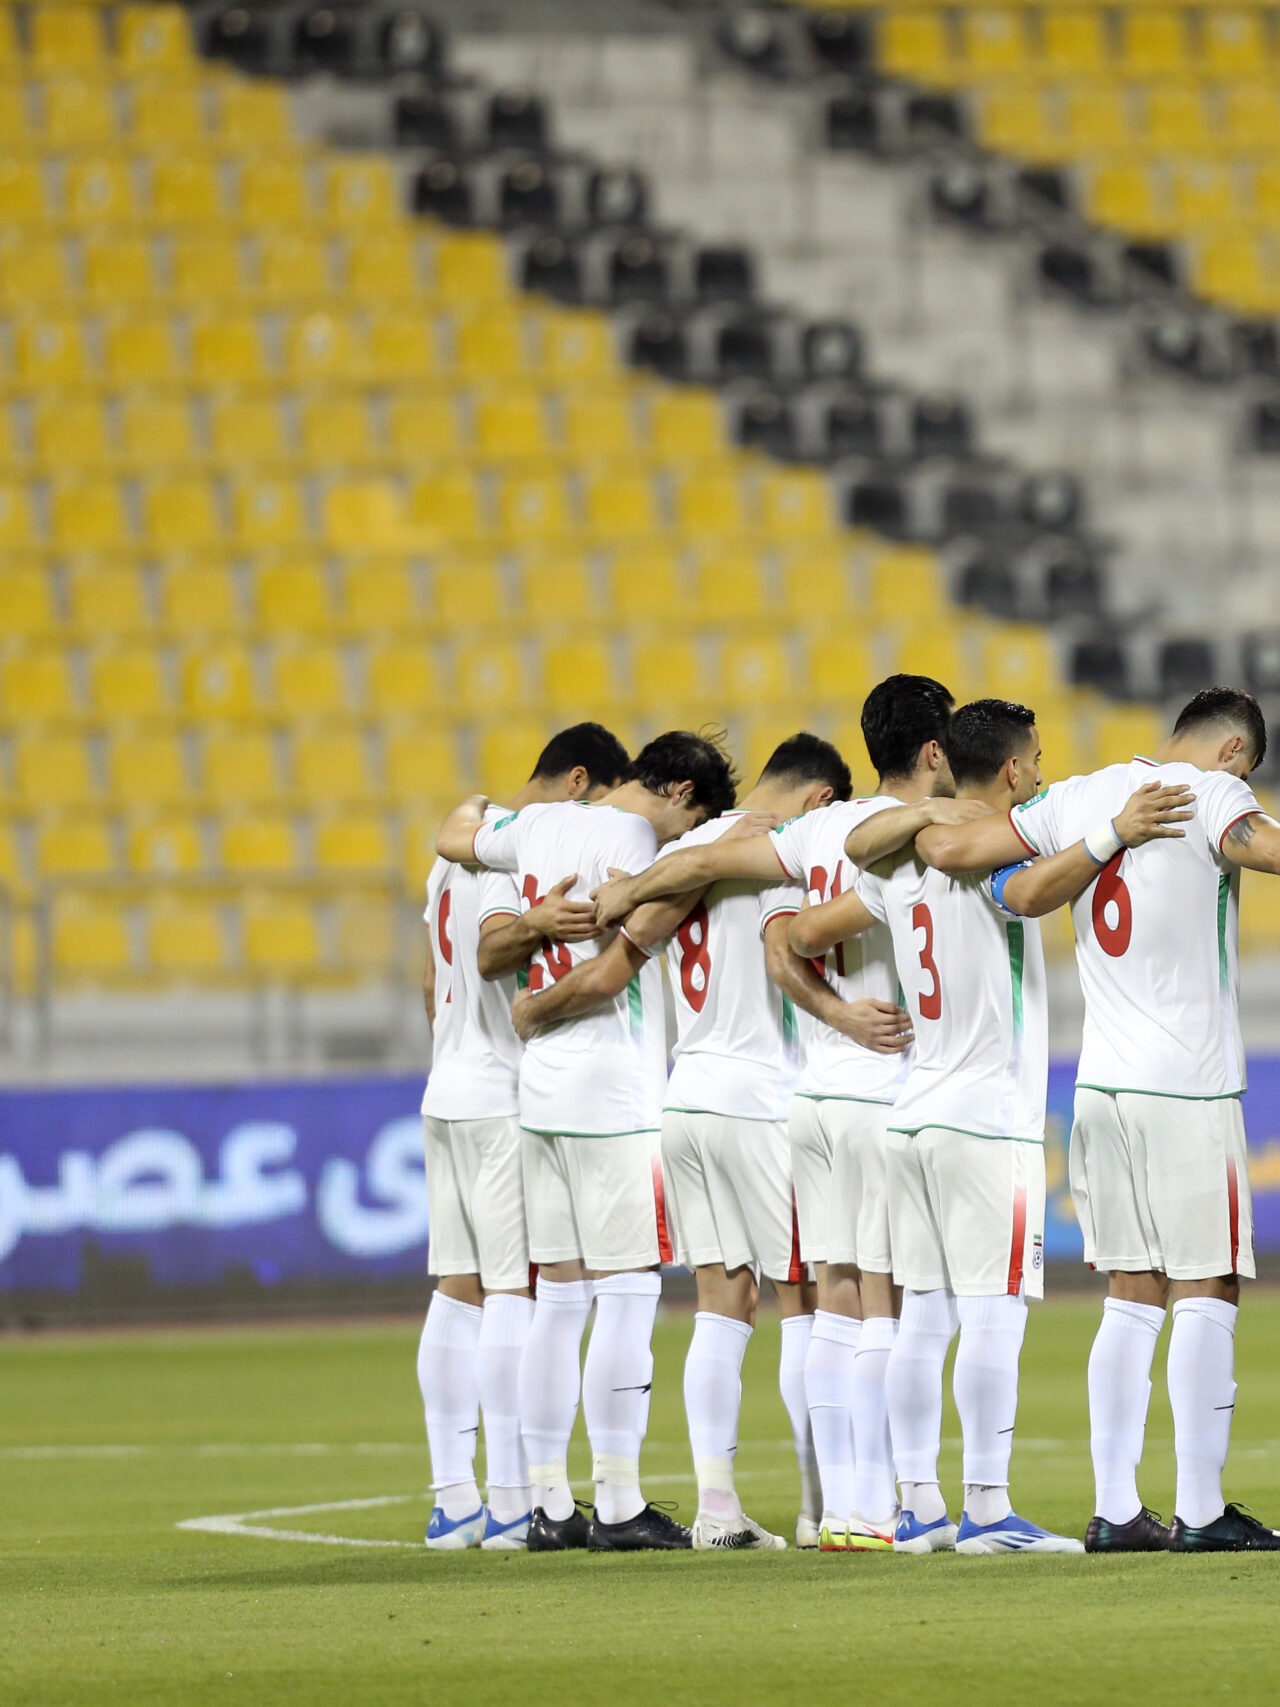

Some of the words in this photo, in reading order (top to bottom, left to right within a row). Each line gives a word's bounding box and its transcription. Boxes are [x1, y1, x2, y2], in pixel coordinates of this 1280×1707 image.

[677, 900, 712, 1014] 8
[1092, 847, 1132, 958] 6
[912, 902, 942, 1020] 3
